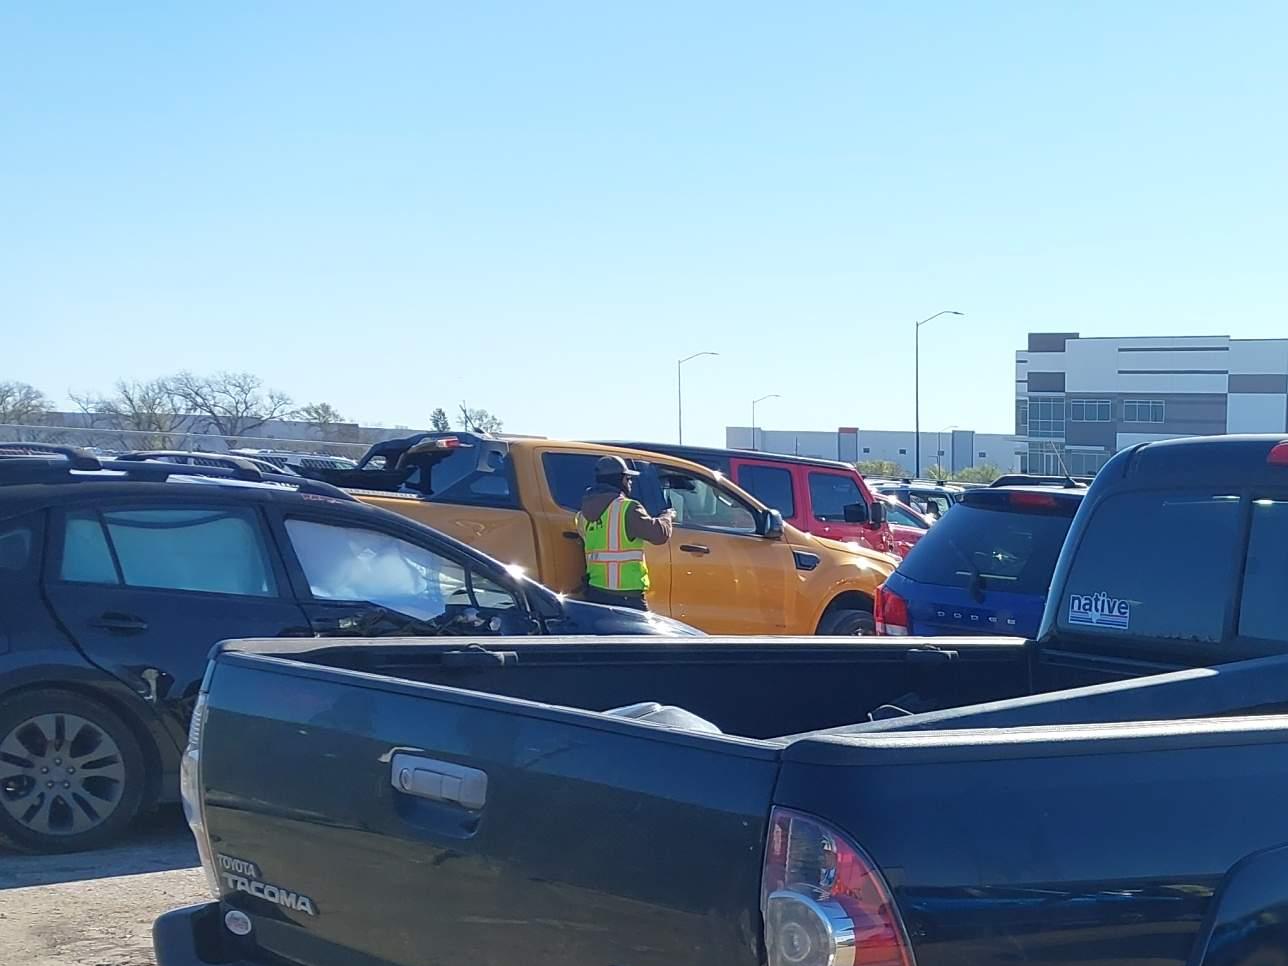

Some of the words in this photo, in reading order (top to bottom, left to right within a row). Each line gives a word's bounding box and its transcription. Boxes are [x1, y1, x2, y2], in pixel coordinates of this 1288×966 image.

[1071, 592, 1129, 615] native
[937, 611, 1016, 625] DODGE
[217, 854, 257, 879] TOYOTA
[222, 871, 315, 917] TACOMA
